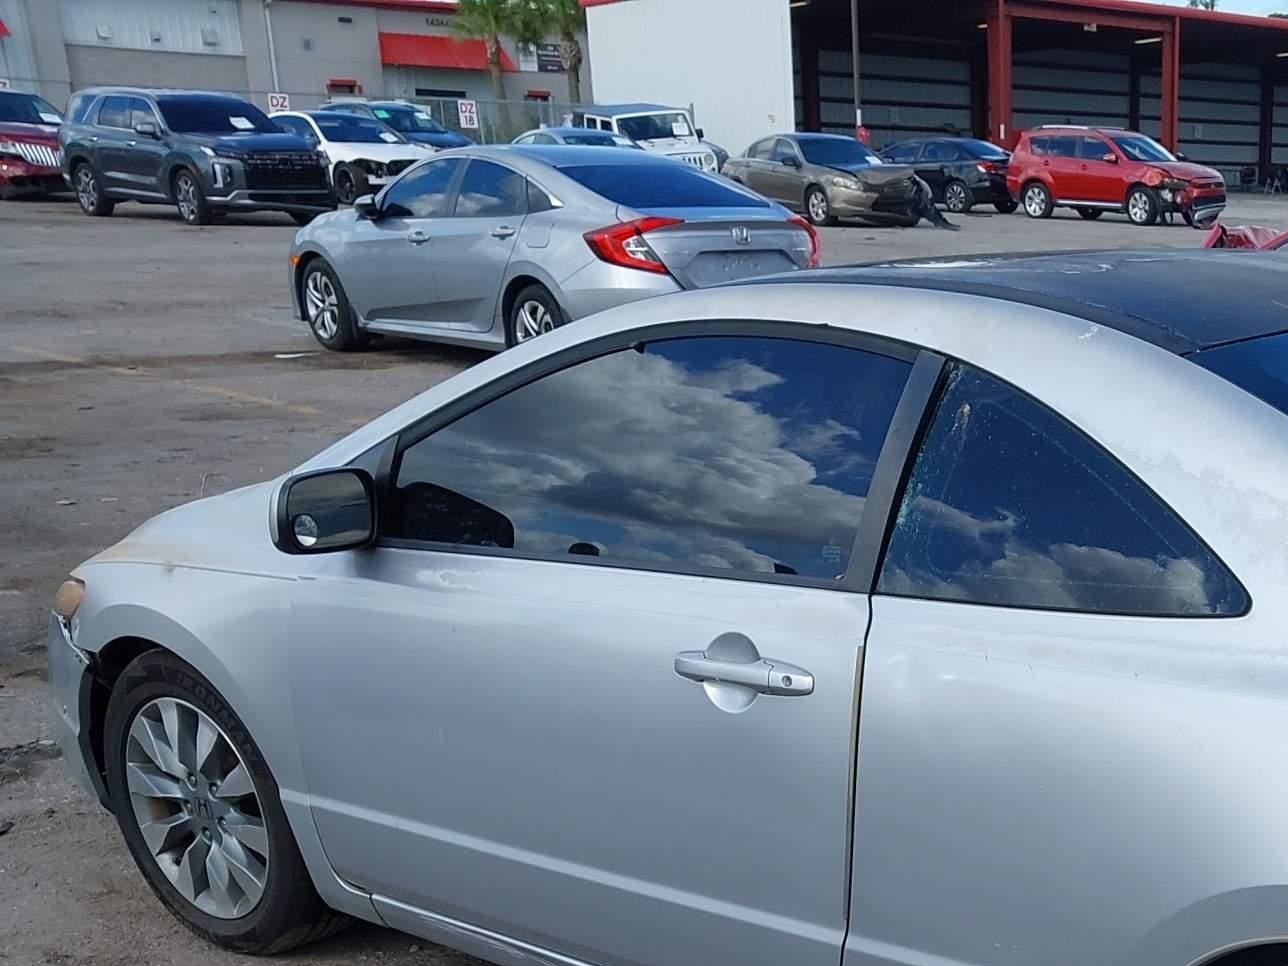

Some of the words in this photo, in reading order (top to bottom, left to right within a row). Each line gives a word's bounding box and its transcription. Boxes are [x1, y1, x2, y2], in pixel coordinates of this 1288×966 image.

[270, 95, 287, 108] DZ
[460, 102, 475, 114] DZ
[464, 115, 475, 126] 18
[176, 672, 260, 762] IRONMAN
